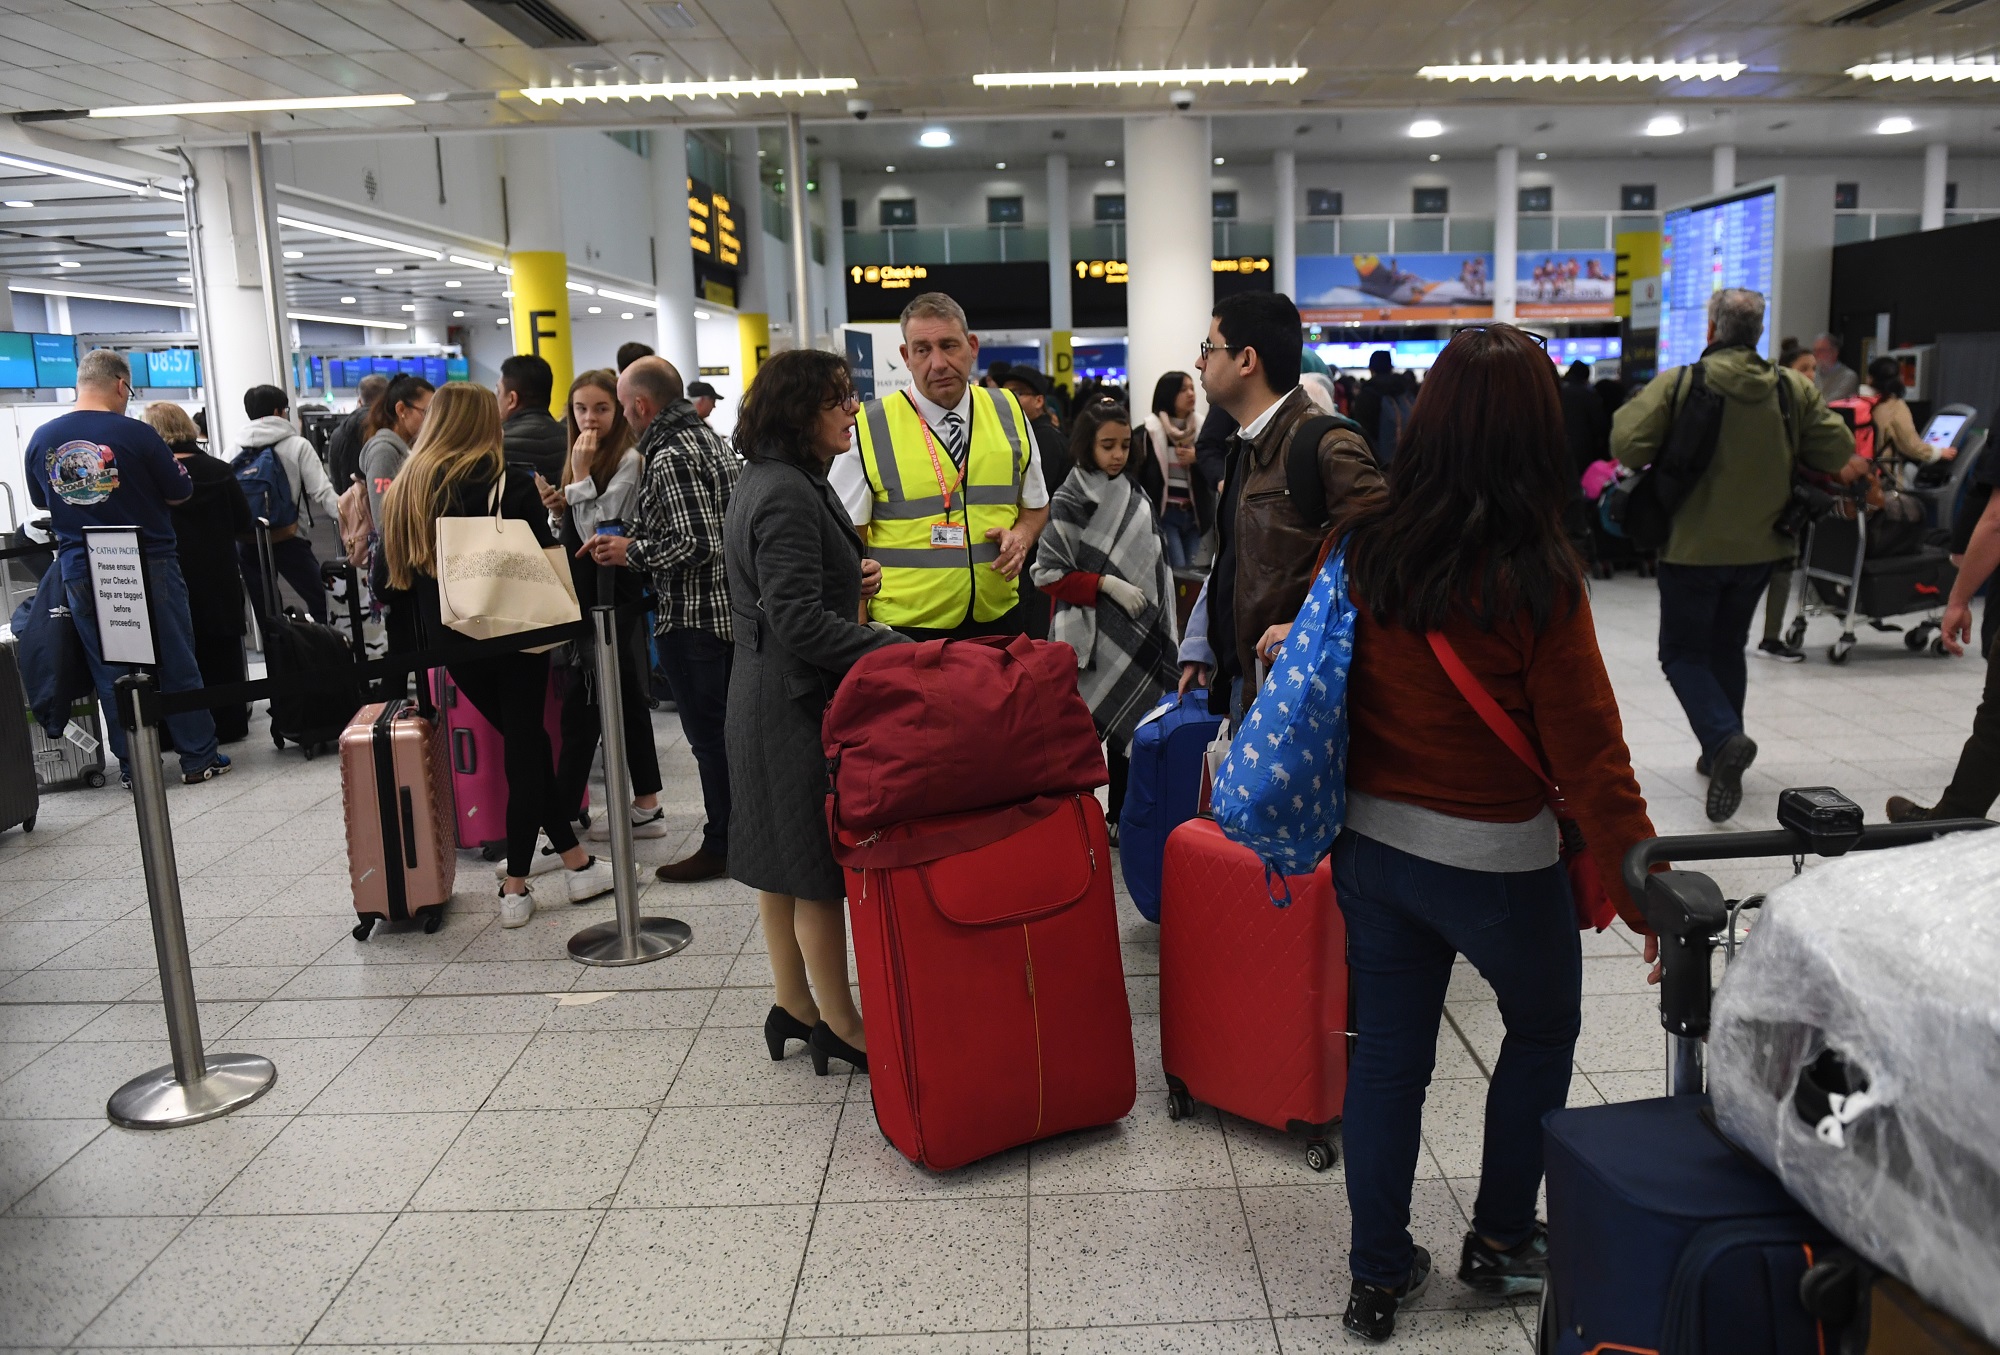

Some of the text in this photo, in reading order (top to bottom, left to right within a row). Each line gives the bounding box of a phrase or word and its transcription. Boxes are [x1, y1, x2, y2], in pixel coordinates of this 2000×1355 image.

[529, 310, 556, 357] F
[150, 349, 191, 371] 08:57
[1056, 352, 1071, 373] D
[921, 424, 948, 496] ESCORTED PASS HOLDER
[58, 480, 85, 493] STONE
[96, 546, 140, 555] CATHAY PACIFIC
[97, 562, 136, 571] Please ensure
[100, 576, 138, 586] your Check-in
[99, 590, 113, 600] Bags
[123, 591, 143, 601] tagged
[113, 605, 131, 613] before
[109, 619, 141, 629] proceeding
